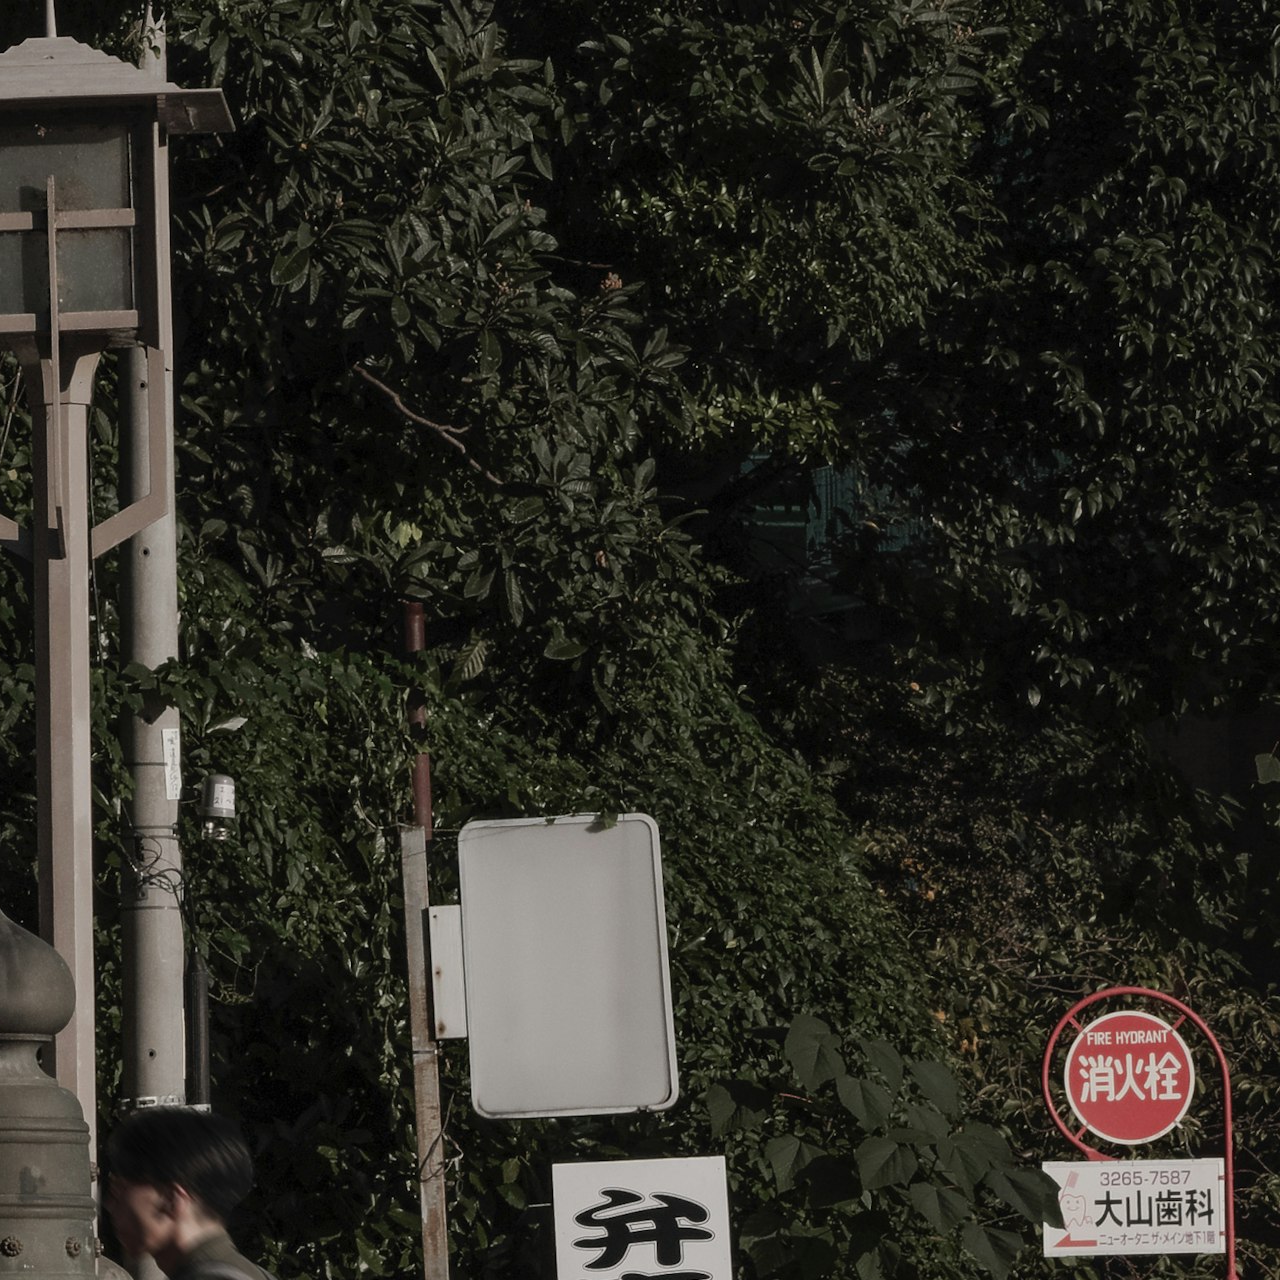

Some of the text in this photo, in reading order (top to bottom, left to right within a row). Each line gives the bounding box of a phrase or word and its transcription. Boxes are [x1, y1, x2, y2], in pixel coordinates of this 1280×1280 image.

[1087, 1029, 1168, 1046] FIRE HYDRANT
[1078, 1051, 1182, 1103] 消火栓
[1099, 1170, 1191, 1187] 3265-7587
[1094, 1188, 1215, 1228] 大山歯科
